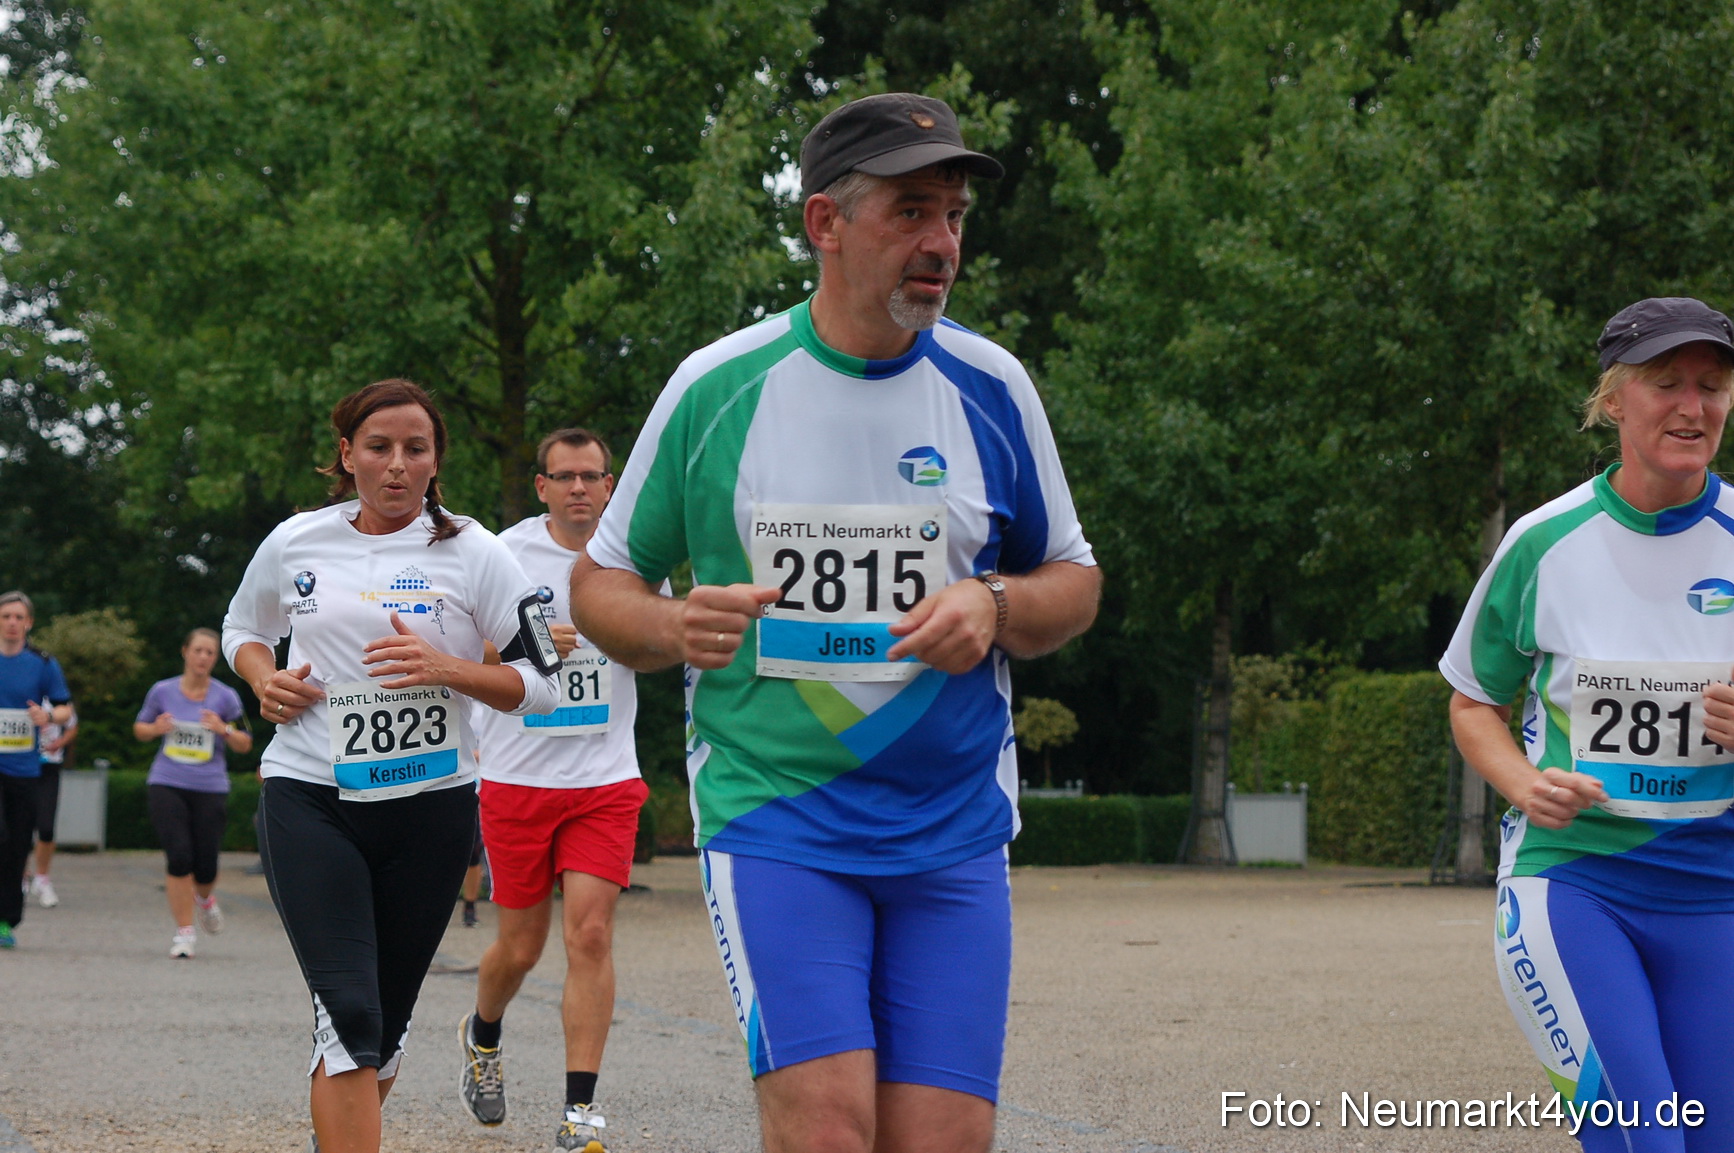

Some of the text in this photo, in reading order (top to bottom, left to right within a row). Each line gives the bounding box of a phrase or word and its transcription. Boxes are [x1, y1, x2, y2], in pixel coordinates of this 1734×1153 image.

[756, 522, 911, 539] PARTL Neumarkt
[773, 548, 926, 613] 2815
[819, 632, 875, 656] Jens
[563, 658, 594, 667] umarkt
[557, 670, 599, 702] 81
[1577, 673, 1721, 693] PARTL Neumar
[330, 689, 436, 708] PARTL Neumarkt
[342, 704, 447, 756] 2823
[369, 761, 427, 784] Kerstin
[1629, 772, 1688, 796] Doris
